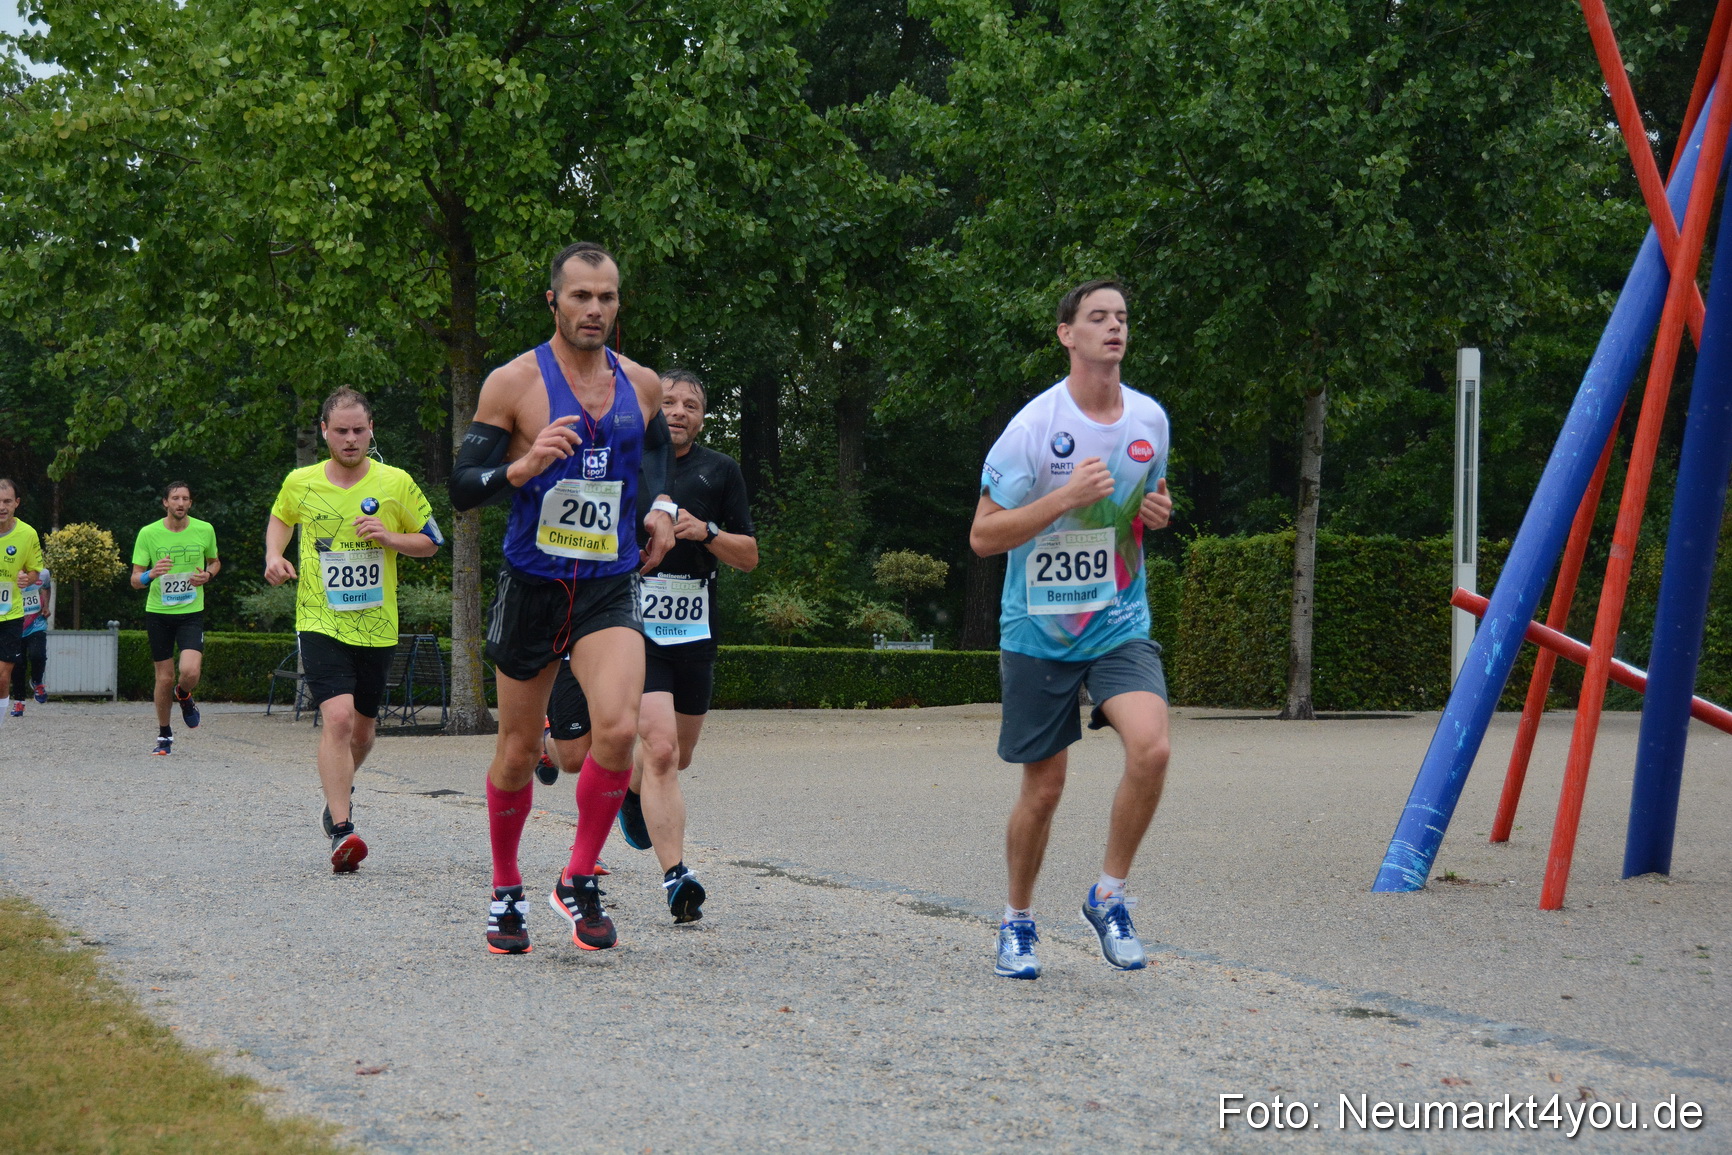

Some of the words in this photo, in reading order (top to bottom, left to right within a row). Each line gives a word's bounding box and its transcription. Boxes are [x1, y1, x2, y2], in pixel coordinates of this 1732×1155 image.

[586, 451, 608, 469] a3
[587, 468, 604, 477] sport
[559, 498, 612, 531] 203
[549, 530, 600, 550] Christian
[601, 538, 610, 550] K.
[1065, 531, 1108, 544] BOCK
[340, 541, 354, 549] THE
[355, 540, 373, 548] NEXT
[1036, 549, 1108, 582] 2369
[327, 563, 380, 588] 2839
[164, 580, 193, 593] 2232
[0, 589, 9, 602] 0
[166, 593, 193, 602] Christopher
[342, 592, 367, 602] Gerrit
[1047, 587, 1098, 602] Bernhard
[642, 593, 703, 621] 2388
[655, 625, 688, 636] Günter
